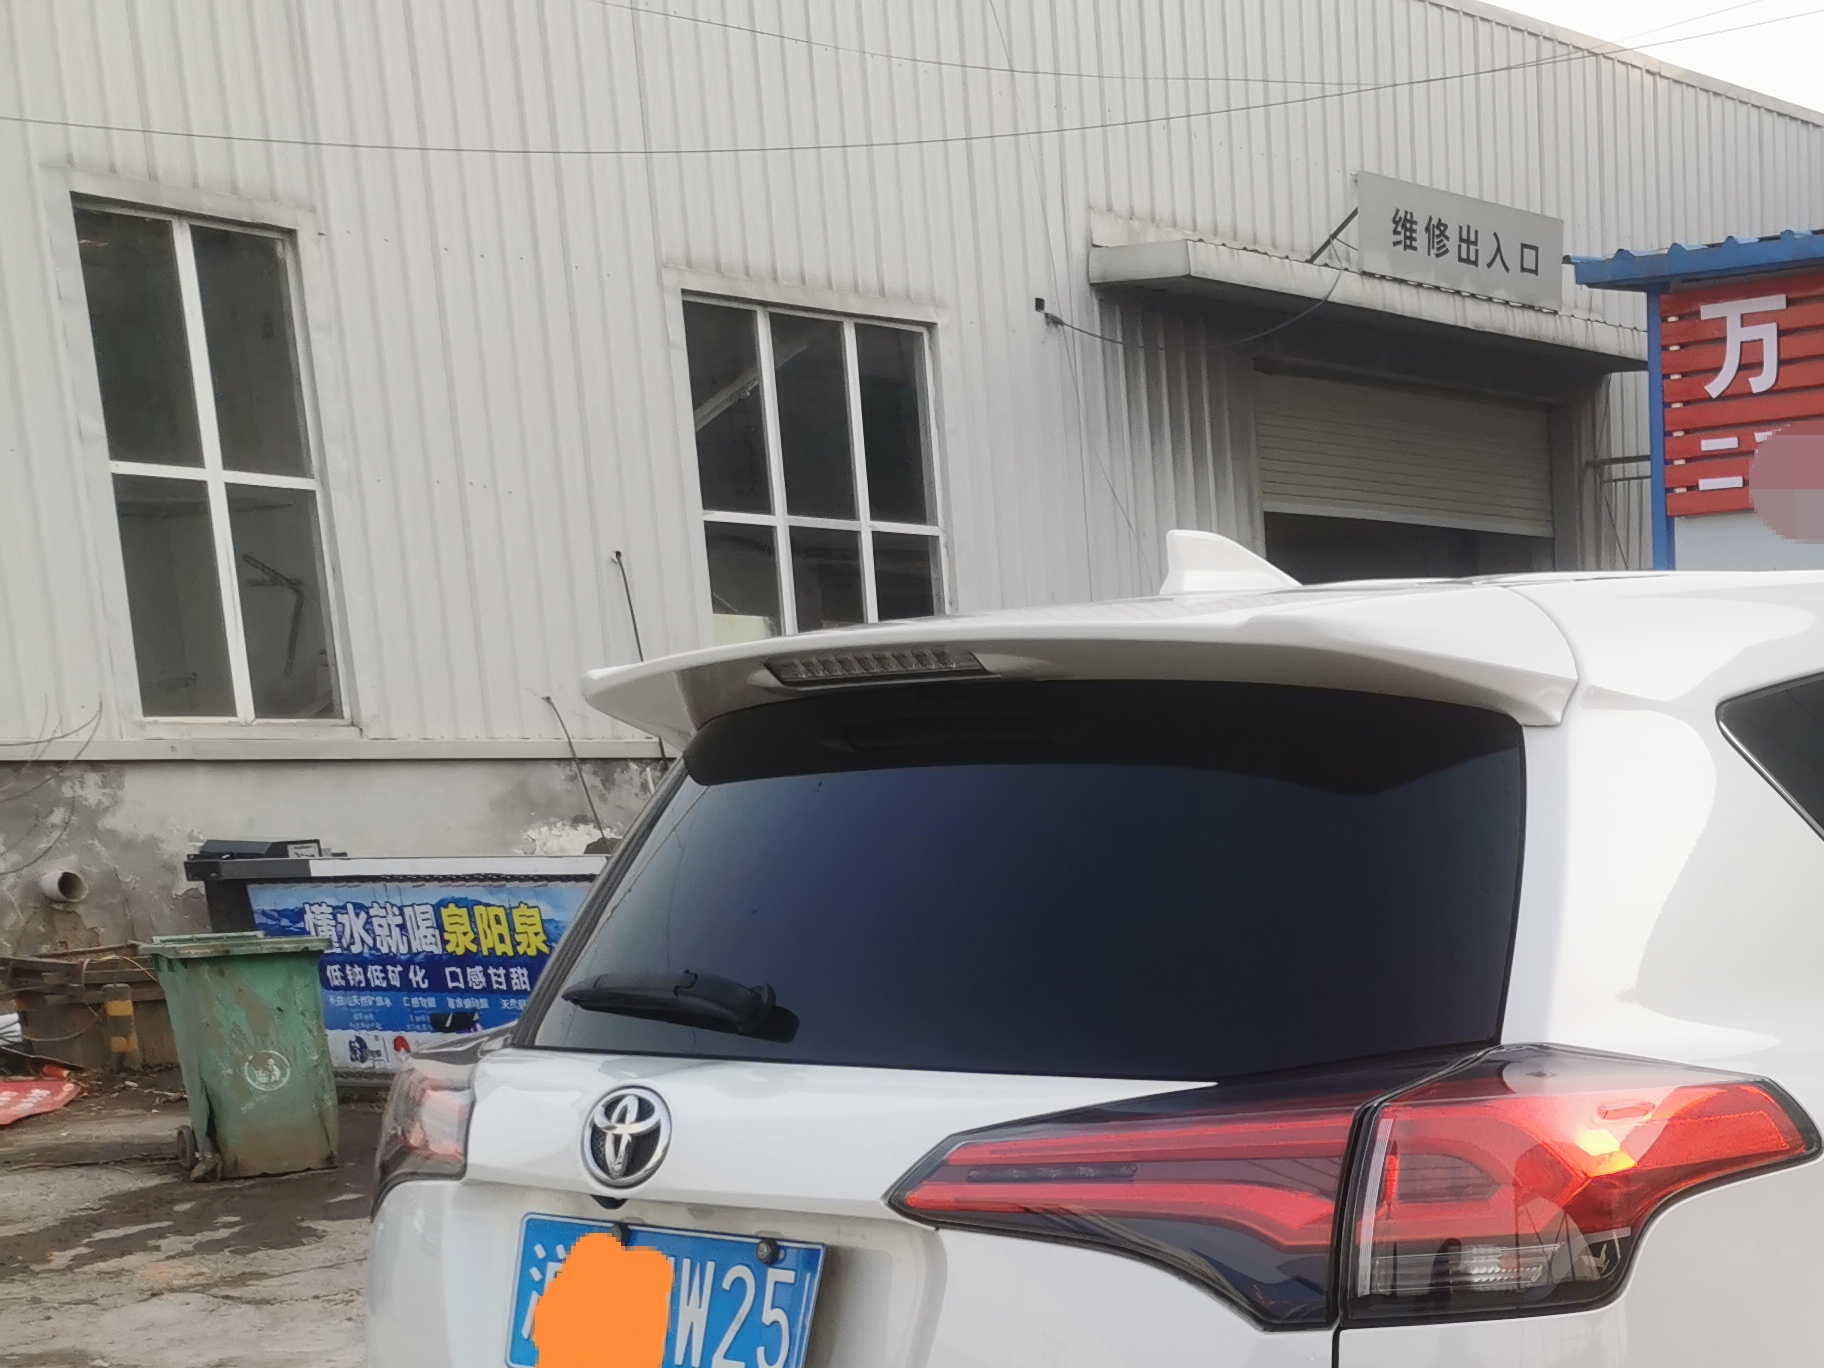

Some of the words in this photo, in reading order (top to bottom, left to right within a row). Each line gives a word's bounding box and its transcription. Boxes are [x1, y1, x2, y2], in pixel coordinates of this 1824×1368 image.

[1392, 208, 1539, 276] 维修出入口
[304, 902, 549, 957] 懂水就喝泉阳泉
[325, 963, 429, 989] 低钠低矿化
[445, 964, 531, 992] 口感甘甜
